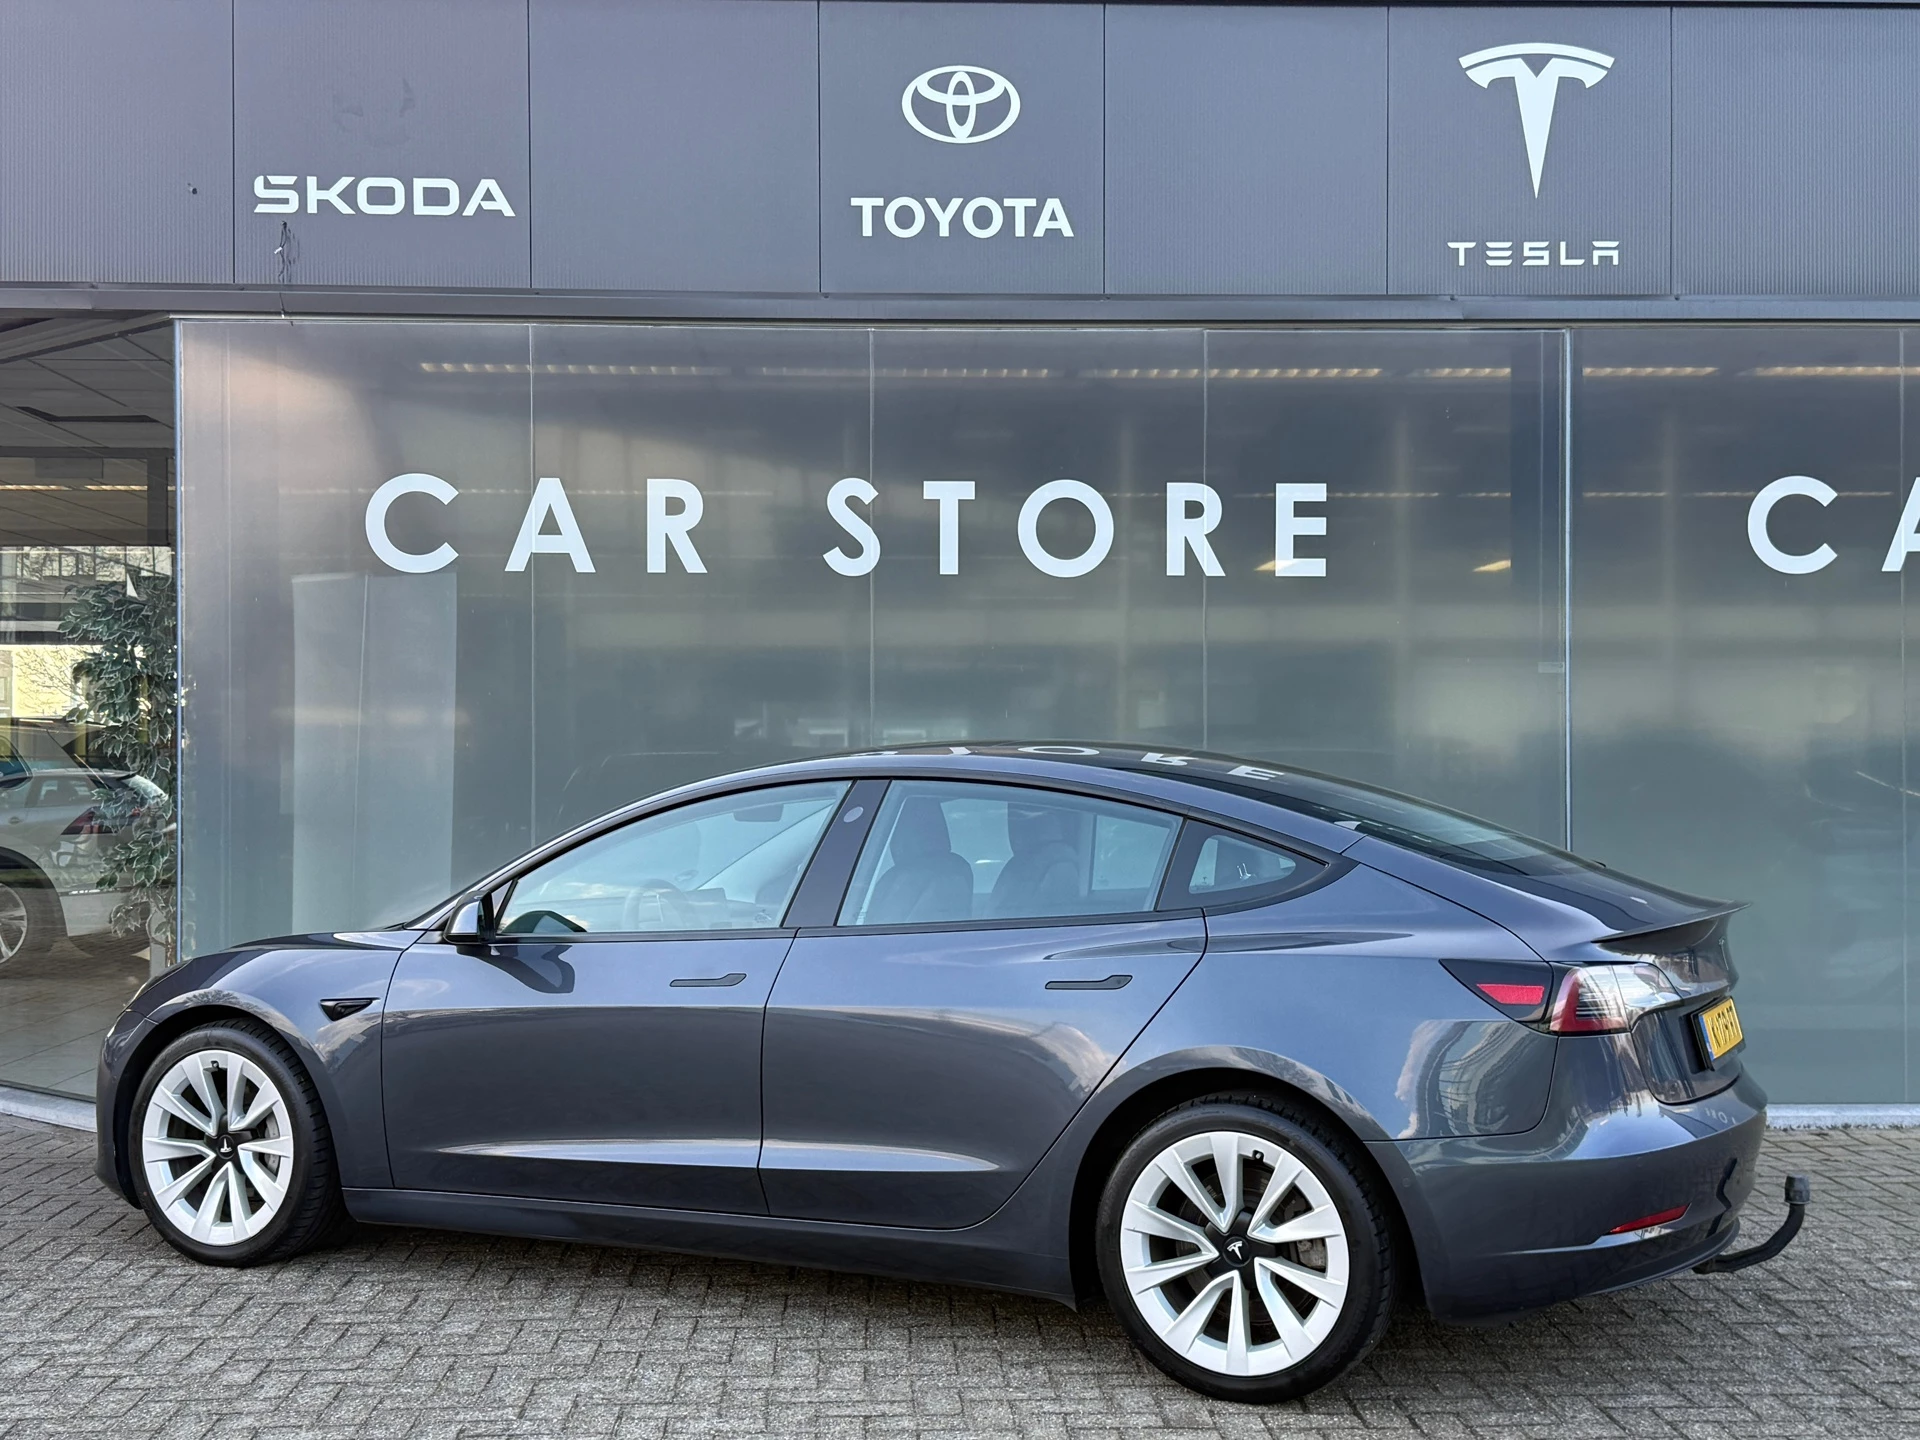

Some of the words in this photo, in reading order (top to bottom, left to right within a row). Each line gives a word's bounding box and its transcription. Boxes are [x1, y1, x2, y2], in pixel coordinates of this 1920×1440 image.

[850, 196, 1075, 239] TOYOTA
[1447, 240, 1620, 267] TESLA
[365, 473, 708, 574] CAR
[823, 477, 1328, 578] STORE
